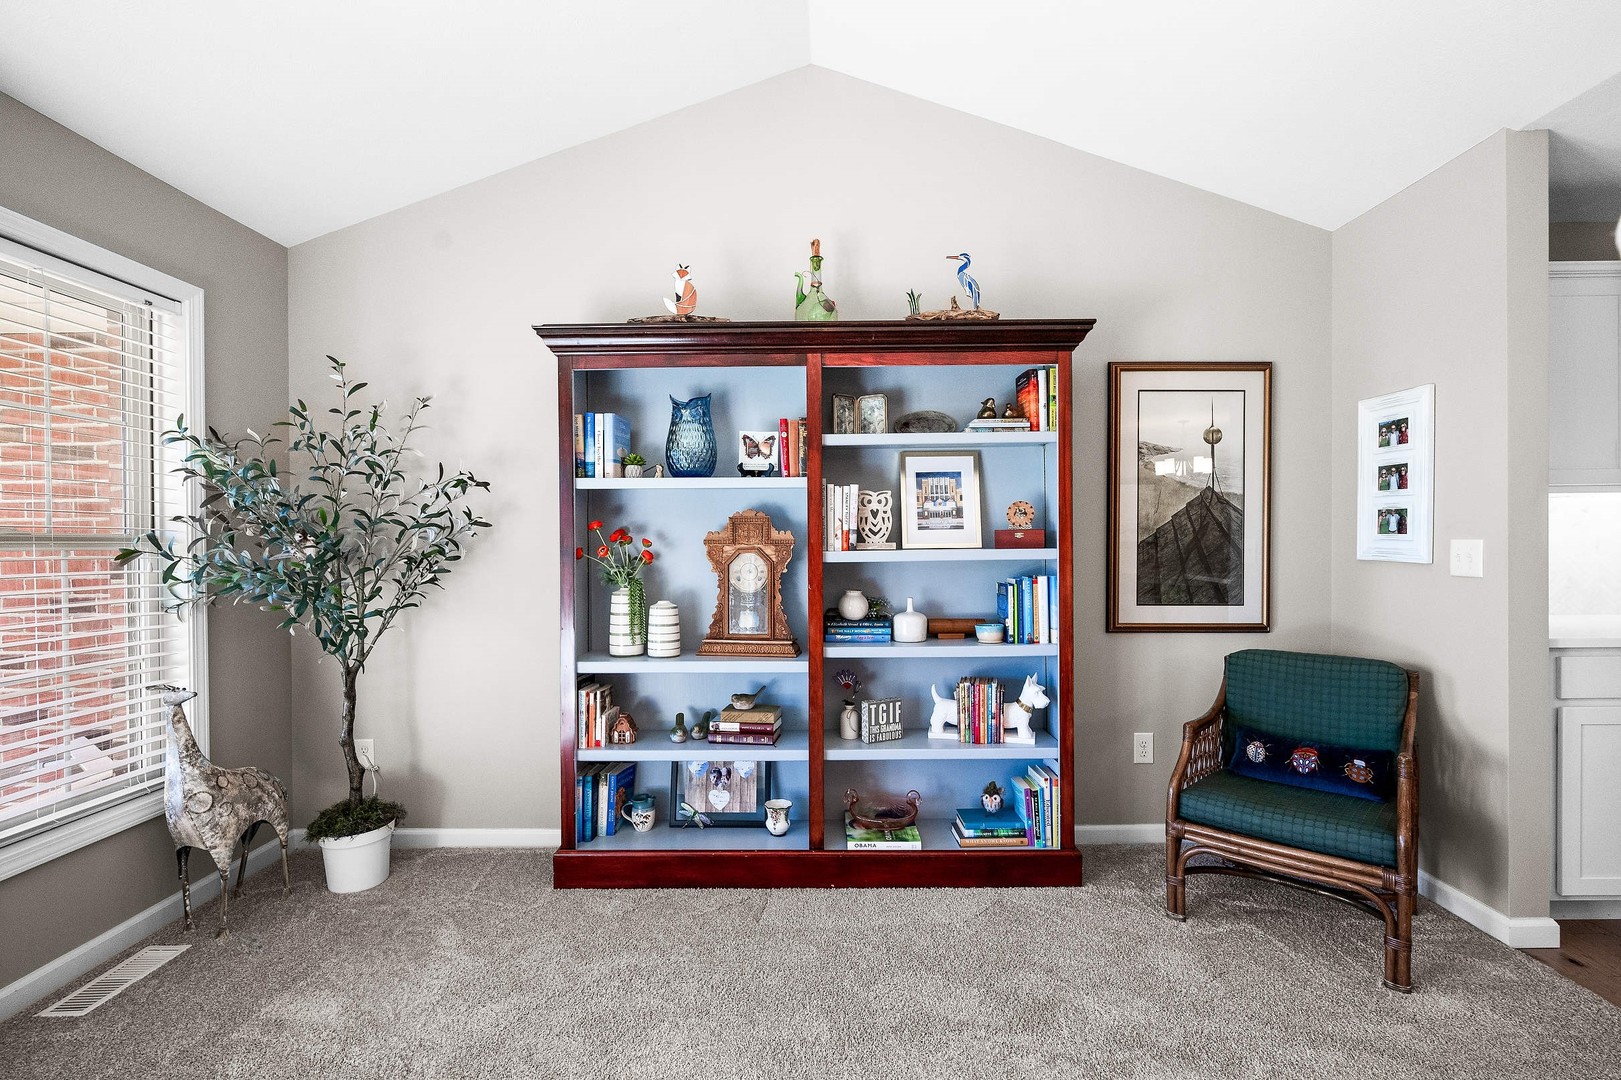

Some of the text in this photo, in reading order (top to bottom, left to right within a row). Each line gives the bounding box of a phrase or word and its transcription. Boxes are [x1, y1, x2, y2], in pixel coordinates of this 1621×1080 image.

[869, 701, 901, 726] TGIF
[869, 722, 902, 734] THIS GRANDMA
[869, 730, 902, 743] IS FABULOUS
